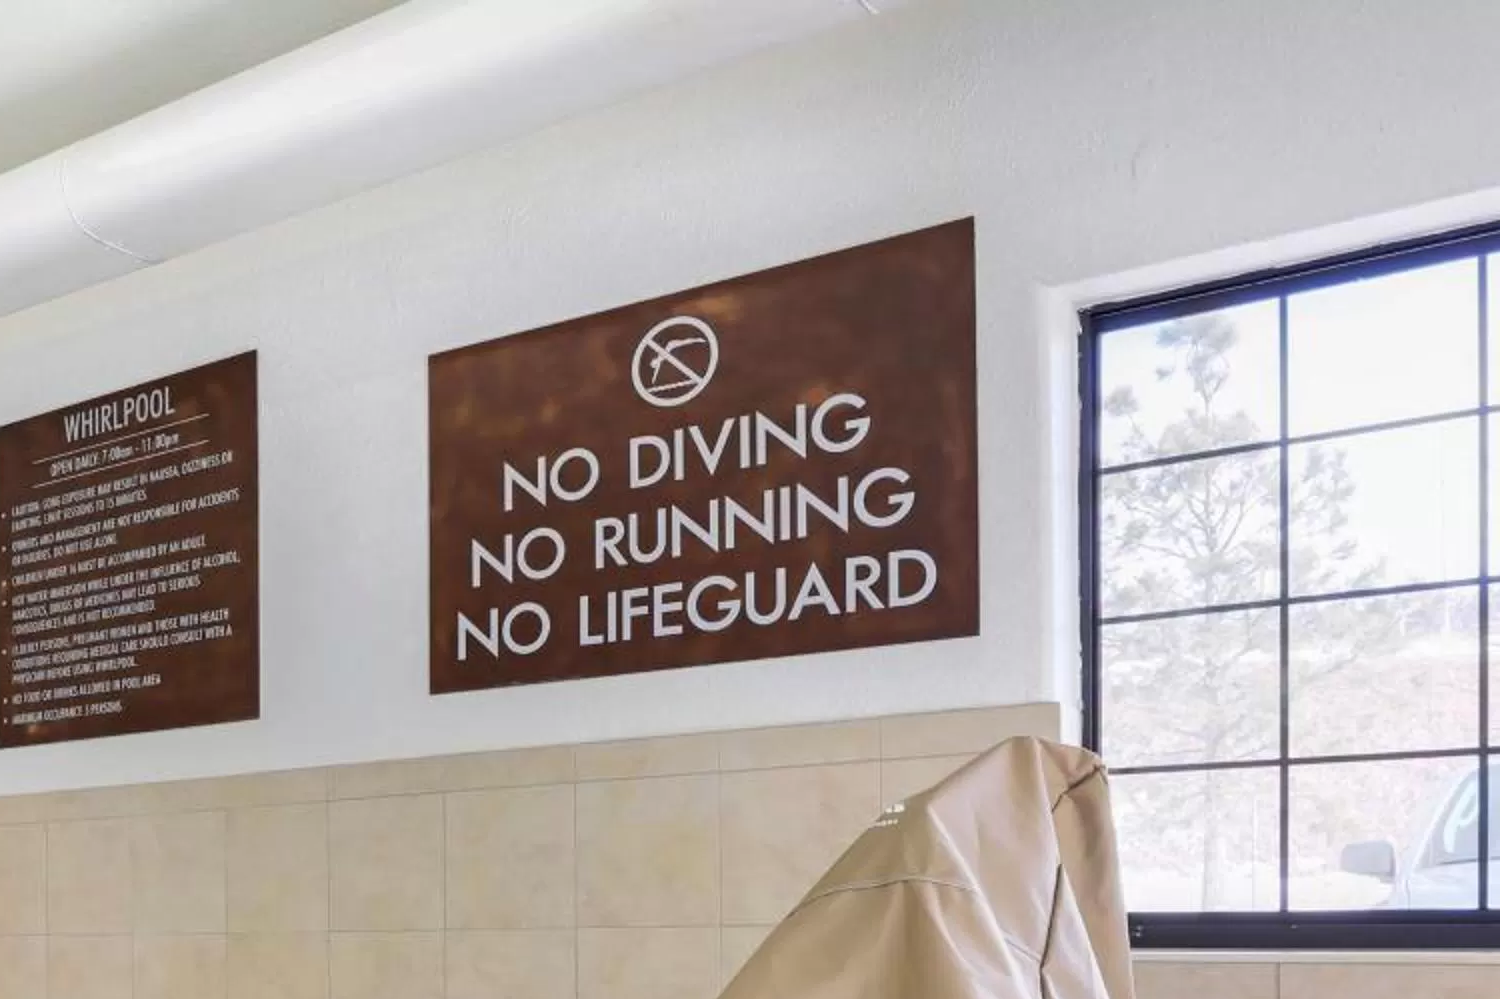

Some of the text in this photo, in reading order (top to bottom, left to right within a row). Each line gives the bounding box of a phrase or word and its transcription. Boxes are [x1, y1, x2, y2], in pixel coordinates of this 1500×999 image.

[64, 384, 175, 444] WHIRLPOOL
[50, 457, 72, 477] OPEN
[503, 393, 871, 513] NO DIVING
[61, 485, 96, 504] EXPOSURE
[97, 481, 111, 495] MAY
[112, 474, 138, 491] RESULT
[139, 471, 147, 485] IN
[55, 520, 101, 541] MANAGEMENT
[102, 516, 116, 531] ARE
[117, 512, 132, 527] NOT
[133, 501, 179, 524] RESPONSIBLE
[181, 497, 196, 513] FOR
[197, 487, 240, 509] ACCIDENTS
[64, 500, 95, 519] SESSIONS
[96, 498, 104, 511] TO
[471, 467, 915, 588] NO RUNNING
[107, 544, 156, 566] ACCOMPANIED
[157, 542, 167, 556] BY
[168, 539, 180, 553] AN
[109, 570, 134, 587] UNDER
[149, 559, 189, 579] INFLUENCE
[191, 557, 201, 571] OF
[137, 582, 156, 598] LEAD
[157, 580, 166, 594] TO
[155, 615, 178, 631] THOSE
[178, 612, 198, 627] WITH
[200, 606, 229, 624] HEALTH
[457, 549, 938, 661] NO LIFEGUARD
[89, 641, 119, 658] MEDICAL
[139, 633, 168, 650] SHOULD
[171, 627, 202, 645] CONSULT
[204, 624, 224, 639] WITH
[225, 622, 232, 636] A
[79, 679, 110, 695] ALLOWED
[111, 678, 120, 691] IN
[122, 675, 141, 689] POOL
